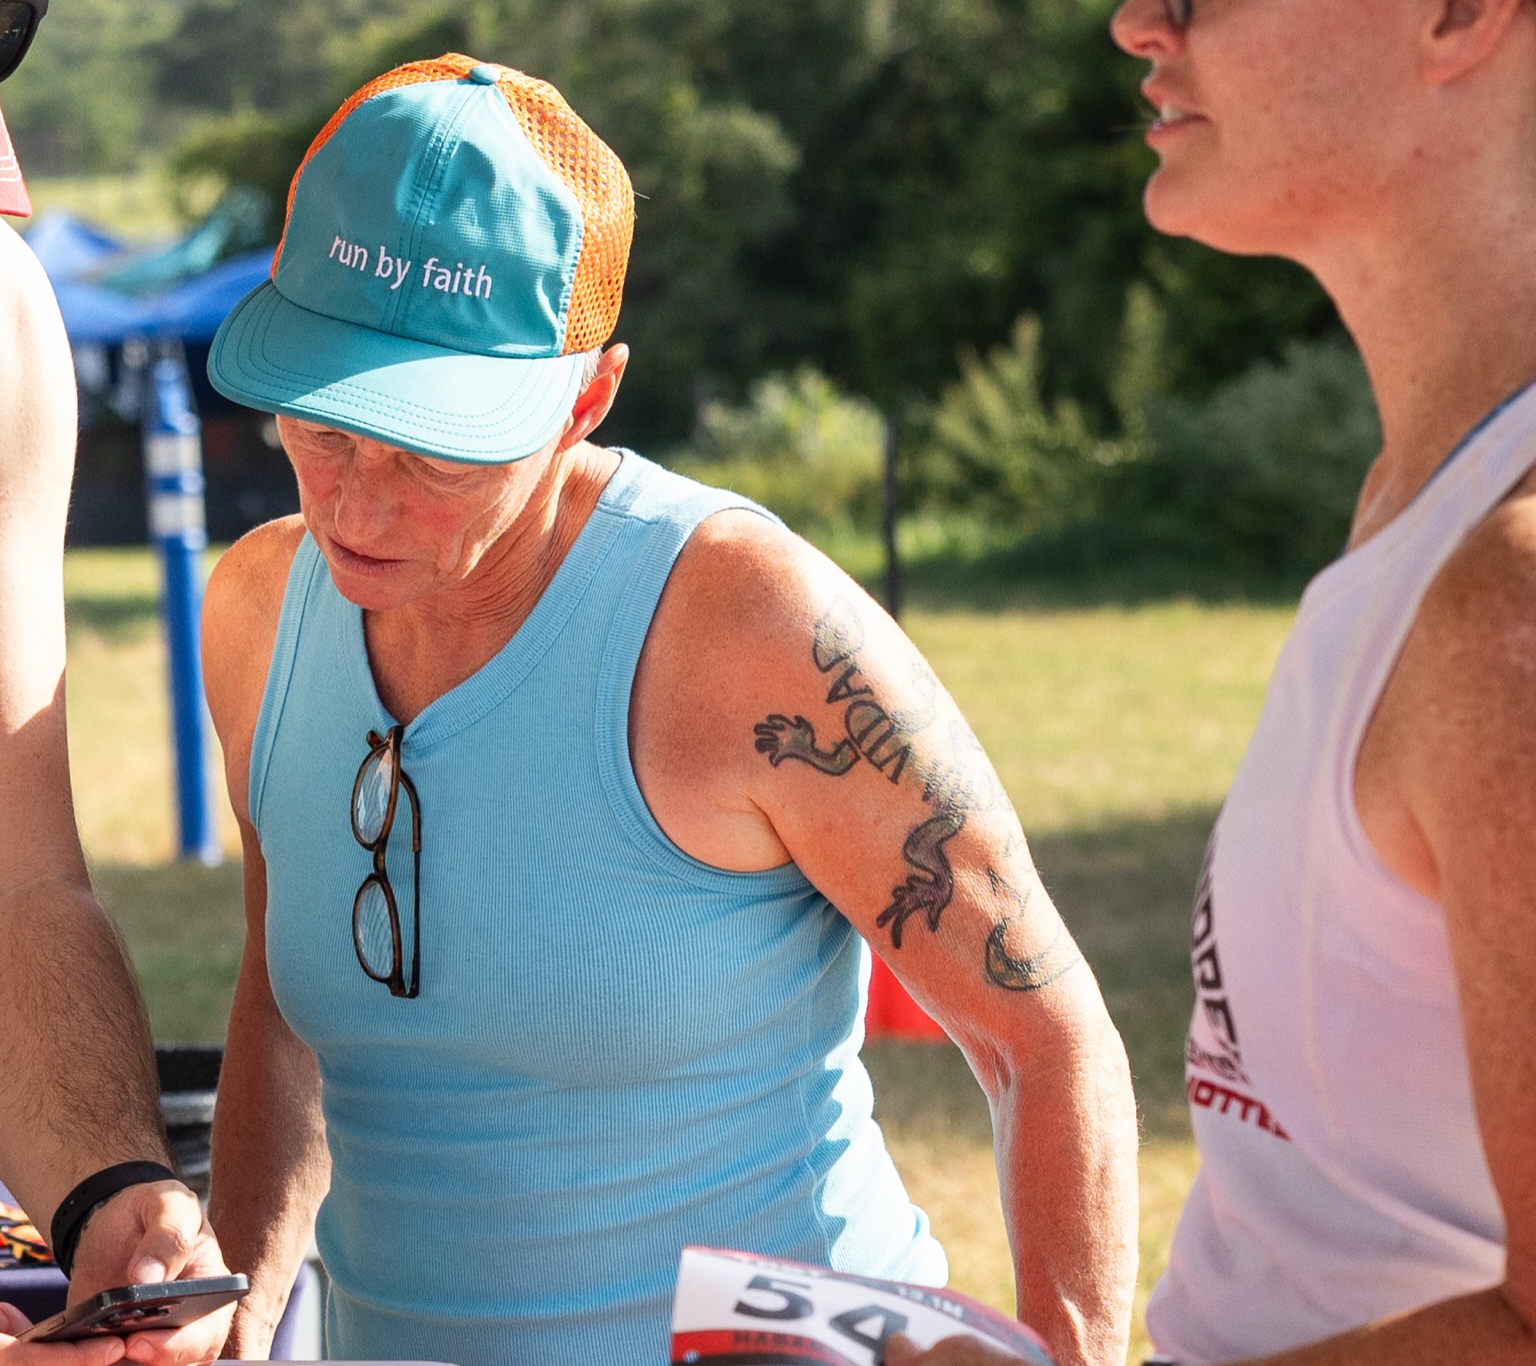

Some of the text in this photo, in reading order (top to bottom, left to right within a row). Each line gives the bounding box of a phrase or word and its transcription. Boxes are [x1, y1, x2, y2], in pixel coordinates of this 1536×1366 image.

[329, 236, 492, 299] run by faith
